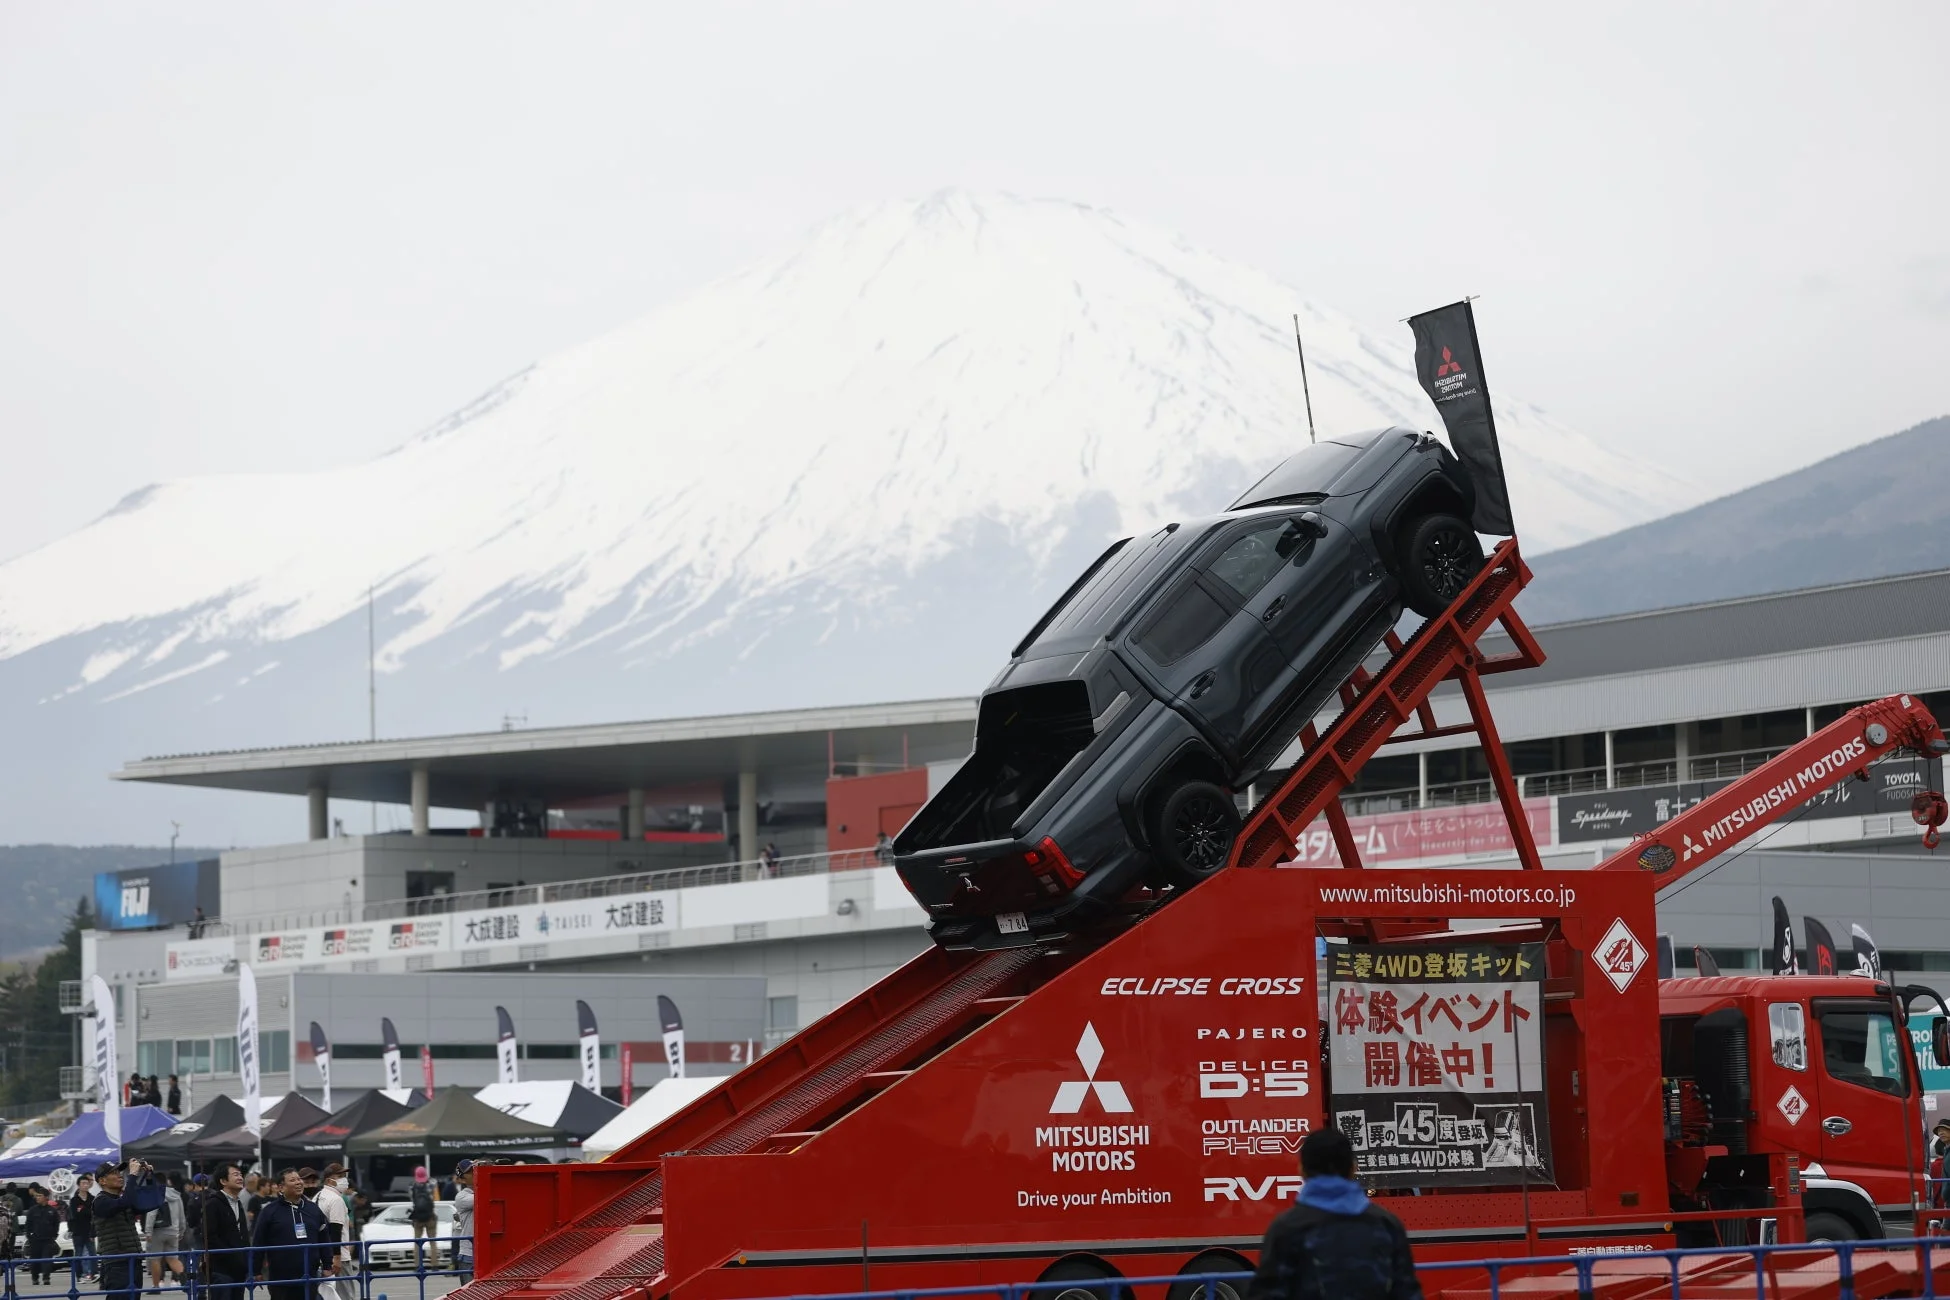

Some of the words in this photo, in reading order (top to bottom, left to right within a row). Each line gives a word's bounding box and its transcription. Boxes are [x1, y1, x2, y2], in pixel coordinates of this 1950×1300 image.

[1885, 772, 1921, 785] TOYOTA
[1702, 779, 1798, 847] MITSUBISHI
[1796, 736, 1867, 790] MOTORS
[1571, 808, 1632, 830] Speedway
[1320, 883, 1576, 908] www.mitsubishi-motors.co.jp
[555, 914, 592, 931] TAISEI
[605, 899, 664, 931] 大成建設
[465, 914, 520, 943] 大成建設
[1335, 953, 1532, 978] 三菱4WD登坂キット
[1100, 977, 1212, 996] ECLIPSE
[1219, 977, 1305, 996] CROSS
[1335, 988, 1532, 1036] 体験イベント
[1197, 1027, 1308, 1040] PAJERO
[729, 1044, 742, 1063] 2
[1363, 1040, 1495, 1089] 開催中!
[1199, 1060, 1309, 1073] DELICA
[1199, 1072, 1309, 1099] D:5
[1035, 1125, 1150, 1148] MITSUBISHI
[1201, 1118, 1310, 1135] OUTLANDER
[1203, 1135, 1308, 1156] PHEV
[1052, 1150, 1136, 1173] MOTORS
[1356, 1149, 1475, 1169] 三菱自動車4WD体験
[1017, 1190, 1058, 1207] Drive
[1062, 1193, 1097, 1210] your
[1101, 1187, 1172, 1205] Ambition
